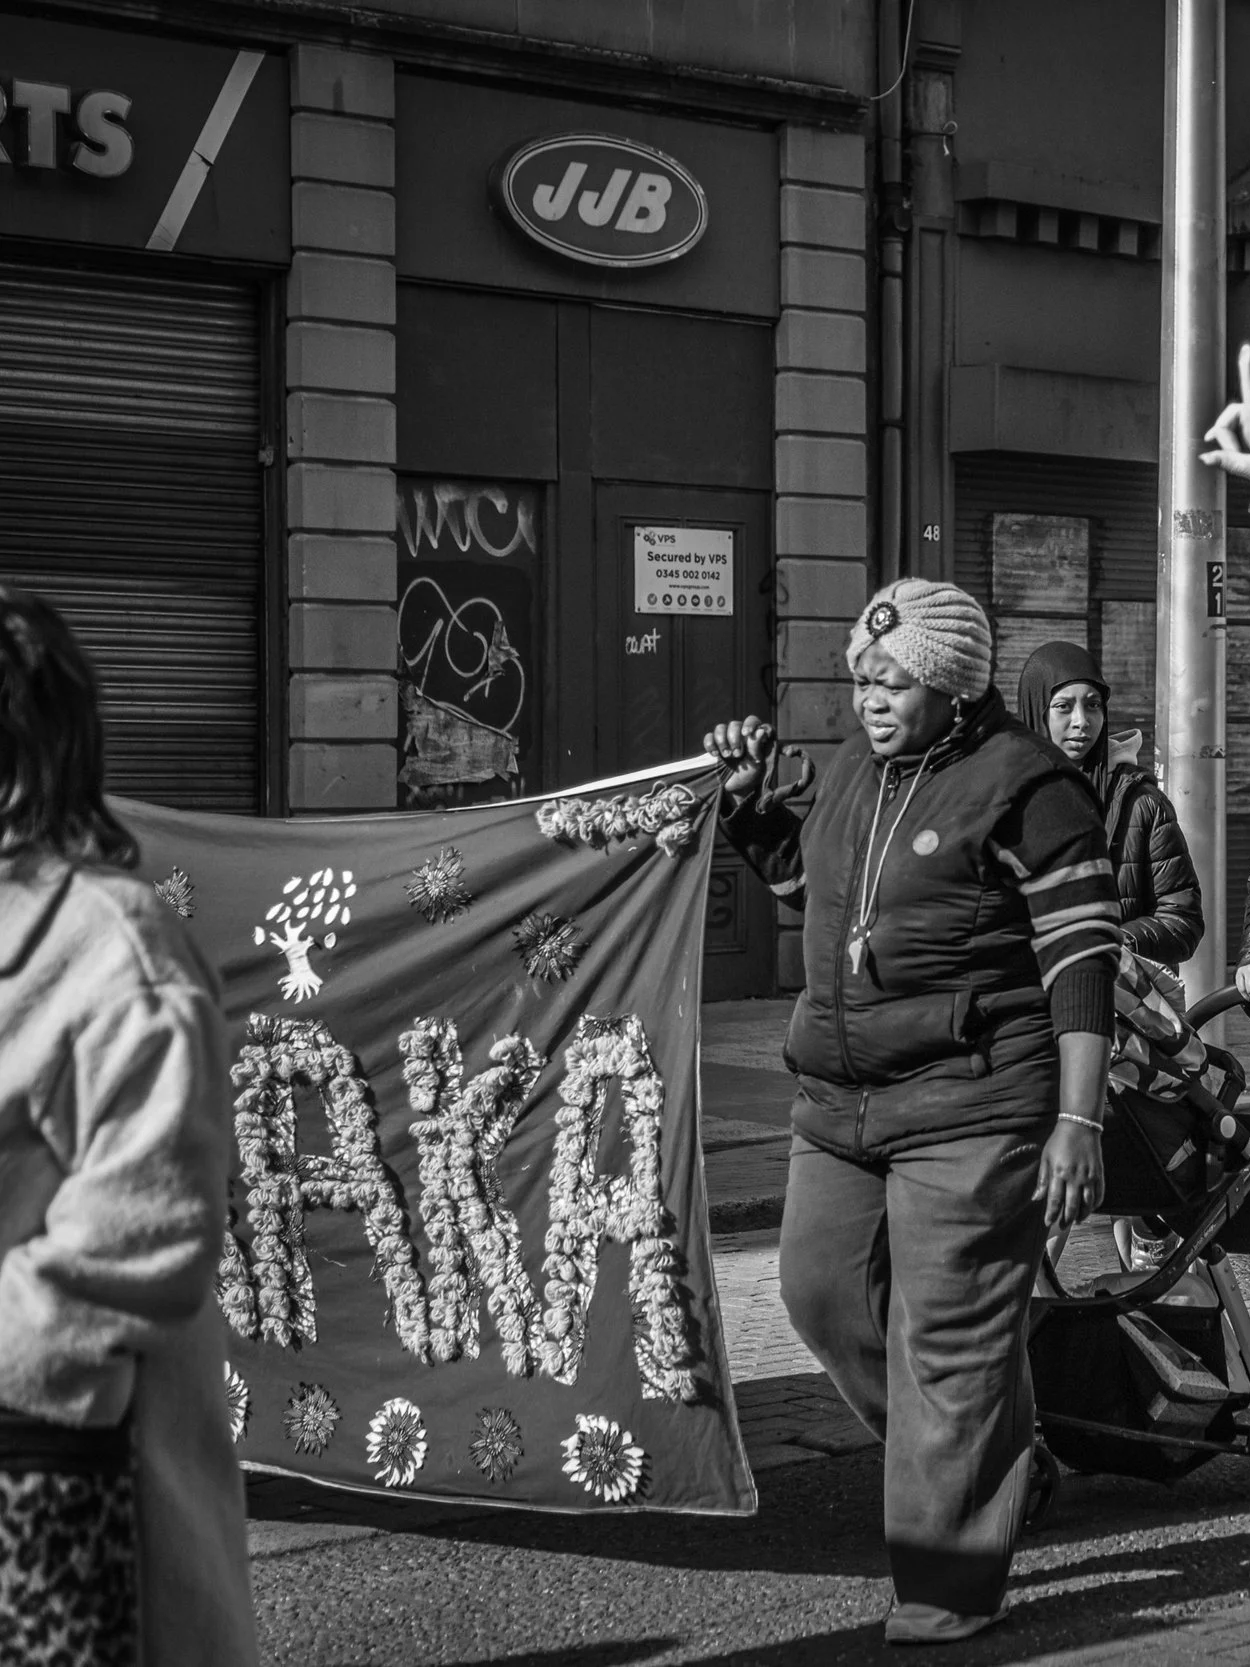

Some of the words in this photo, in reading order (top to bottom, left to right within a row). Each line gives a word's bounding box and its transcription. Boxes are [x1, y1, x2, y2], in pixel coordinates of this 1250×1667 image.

[0, 77, 134, 178] TS
[532, 161, 674, 235] JJB
[657, 534, 676, 544] VPS
[923, 524, 941, 542] 48
[647, 551, 692, 563] Secured
[694, 552, 706, 566] by
[708, 554, 728, 565] VPS
[656, 569, 680, 579] 0345
[682, 570, 699, 580] 002
[701, 571, 720, 581] 0142
[217, 1012, 698, 1401] AKA
